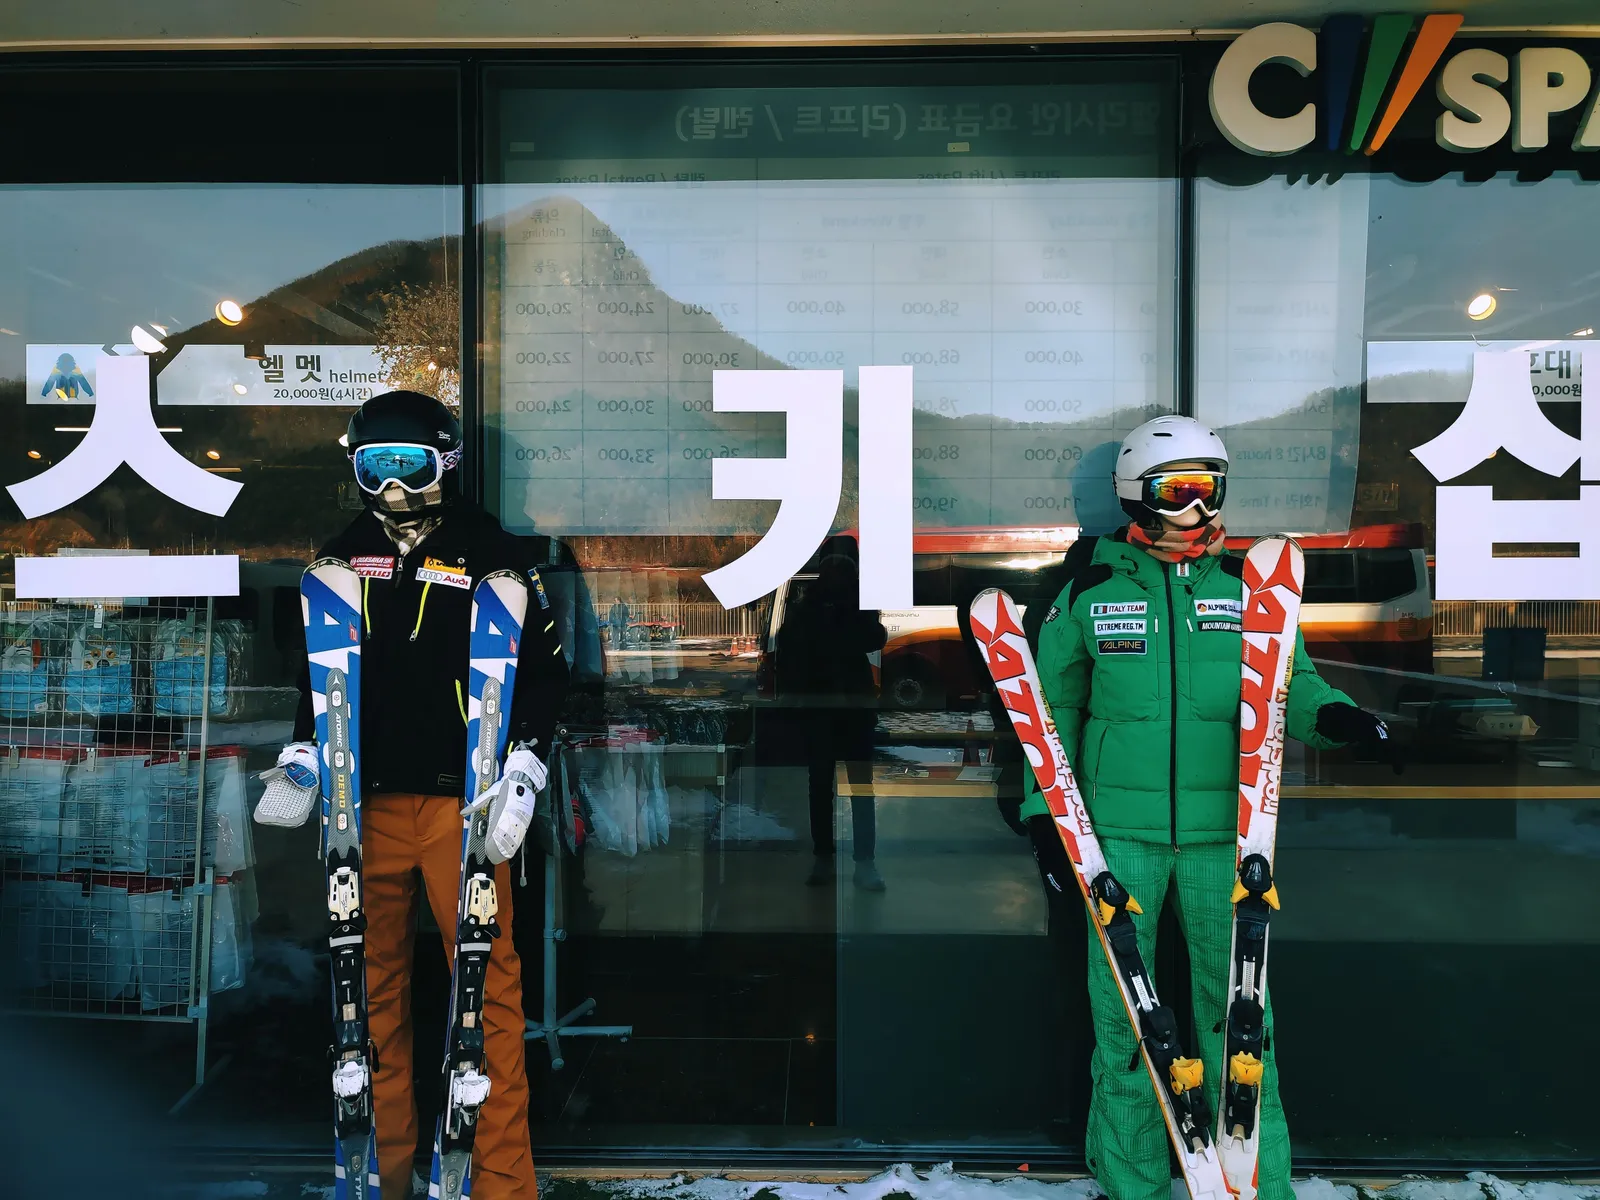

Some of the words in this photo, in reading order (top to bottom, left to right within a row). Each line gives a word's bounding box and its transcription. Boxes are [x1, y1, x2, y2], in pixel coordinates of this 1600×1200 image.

[1436, 47, 1600, 154] SP
[329, 369, 382, 383] helmet
[273, 387, 373, 401] 20,000원(4시간)
[443, 575, 469, 586] Audi
[1108, 605, 1126, 613] ITALY
[1127, 604, 1145, 612] TEAM
[1207, 604, 1228, 612] ALPINE
[1097, 623, 1122, 632] EXTREME
[1201, 622, 1231, 631] MOUNTAIN
[335, 712, 344, 748] ATOMIC
[482, 721, 492, 757] ATOMIC
[338, 774, 346, 809] DEMO
[480, 781, 489, 815] DO
